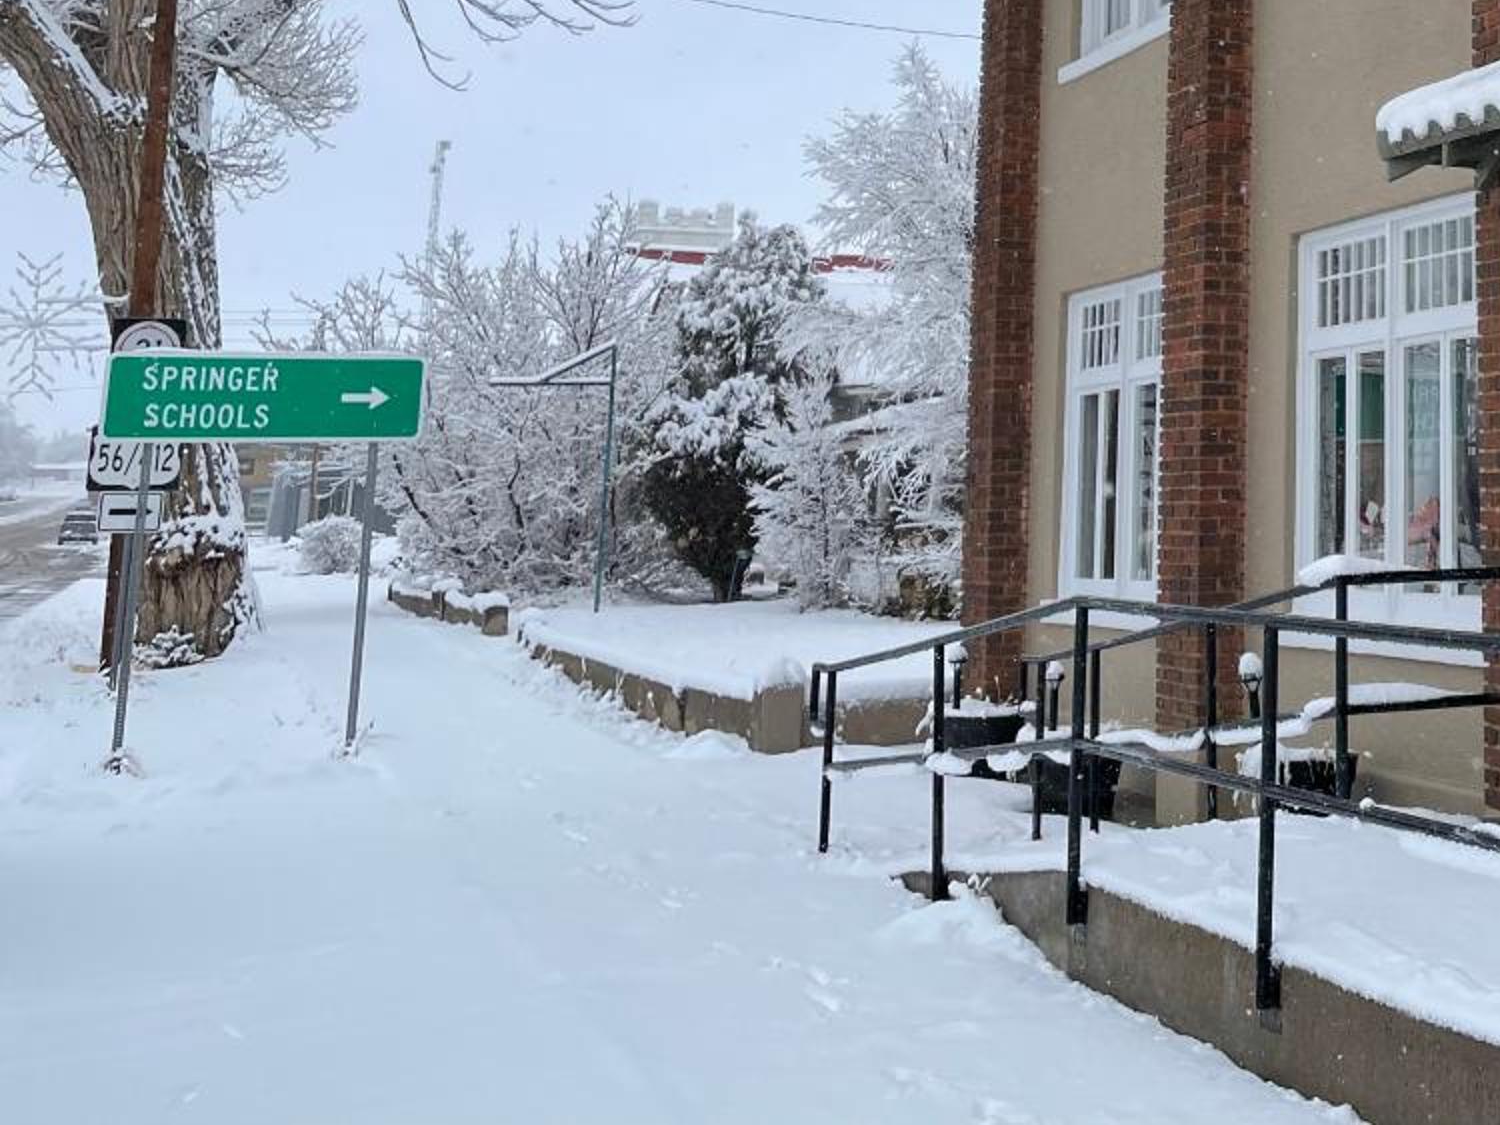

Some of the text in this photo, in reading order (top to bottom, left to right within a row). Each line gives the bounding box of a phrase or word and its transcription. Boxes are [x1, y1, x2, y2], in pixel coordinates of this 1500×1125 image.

[142, 364, 279, 392] SPRINGER
[143, 403, 270, 429] SCHOOLS
[97, 442, 175, 475] 56/12
